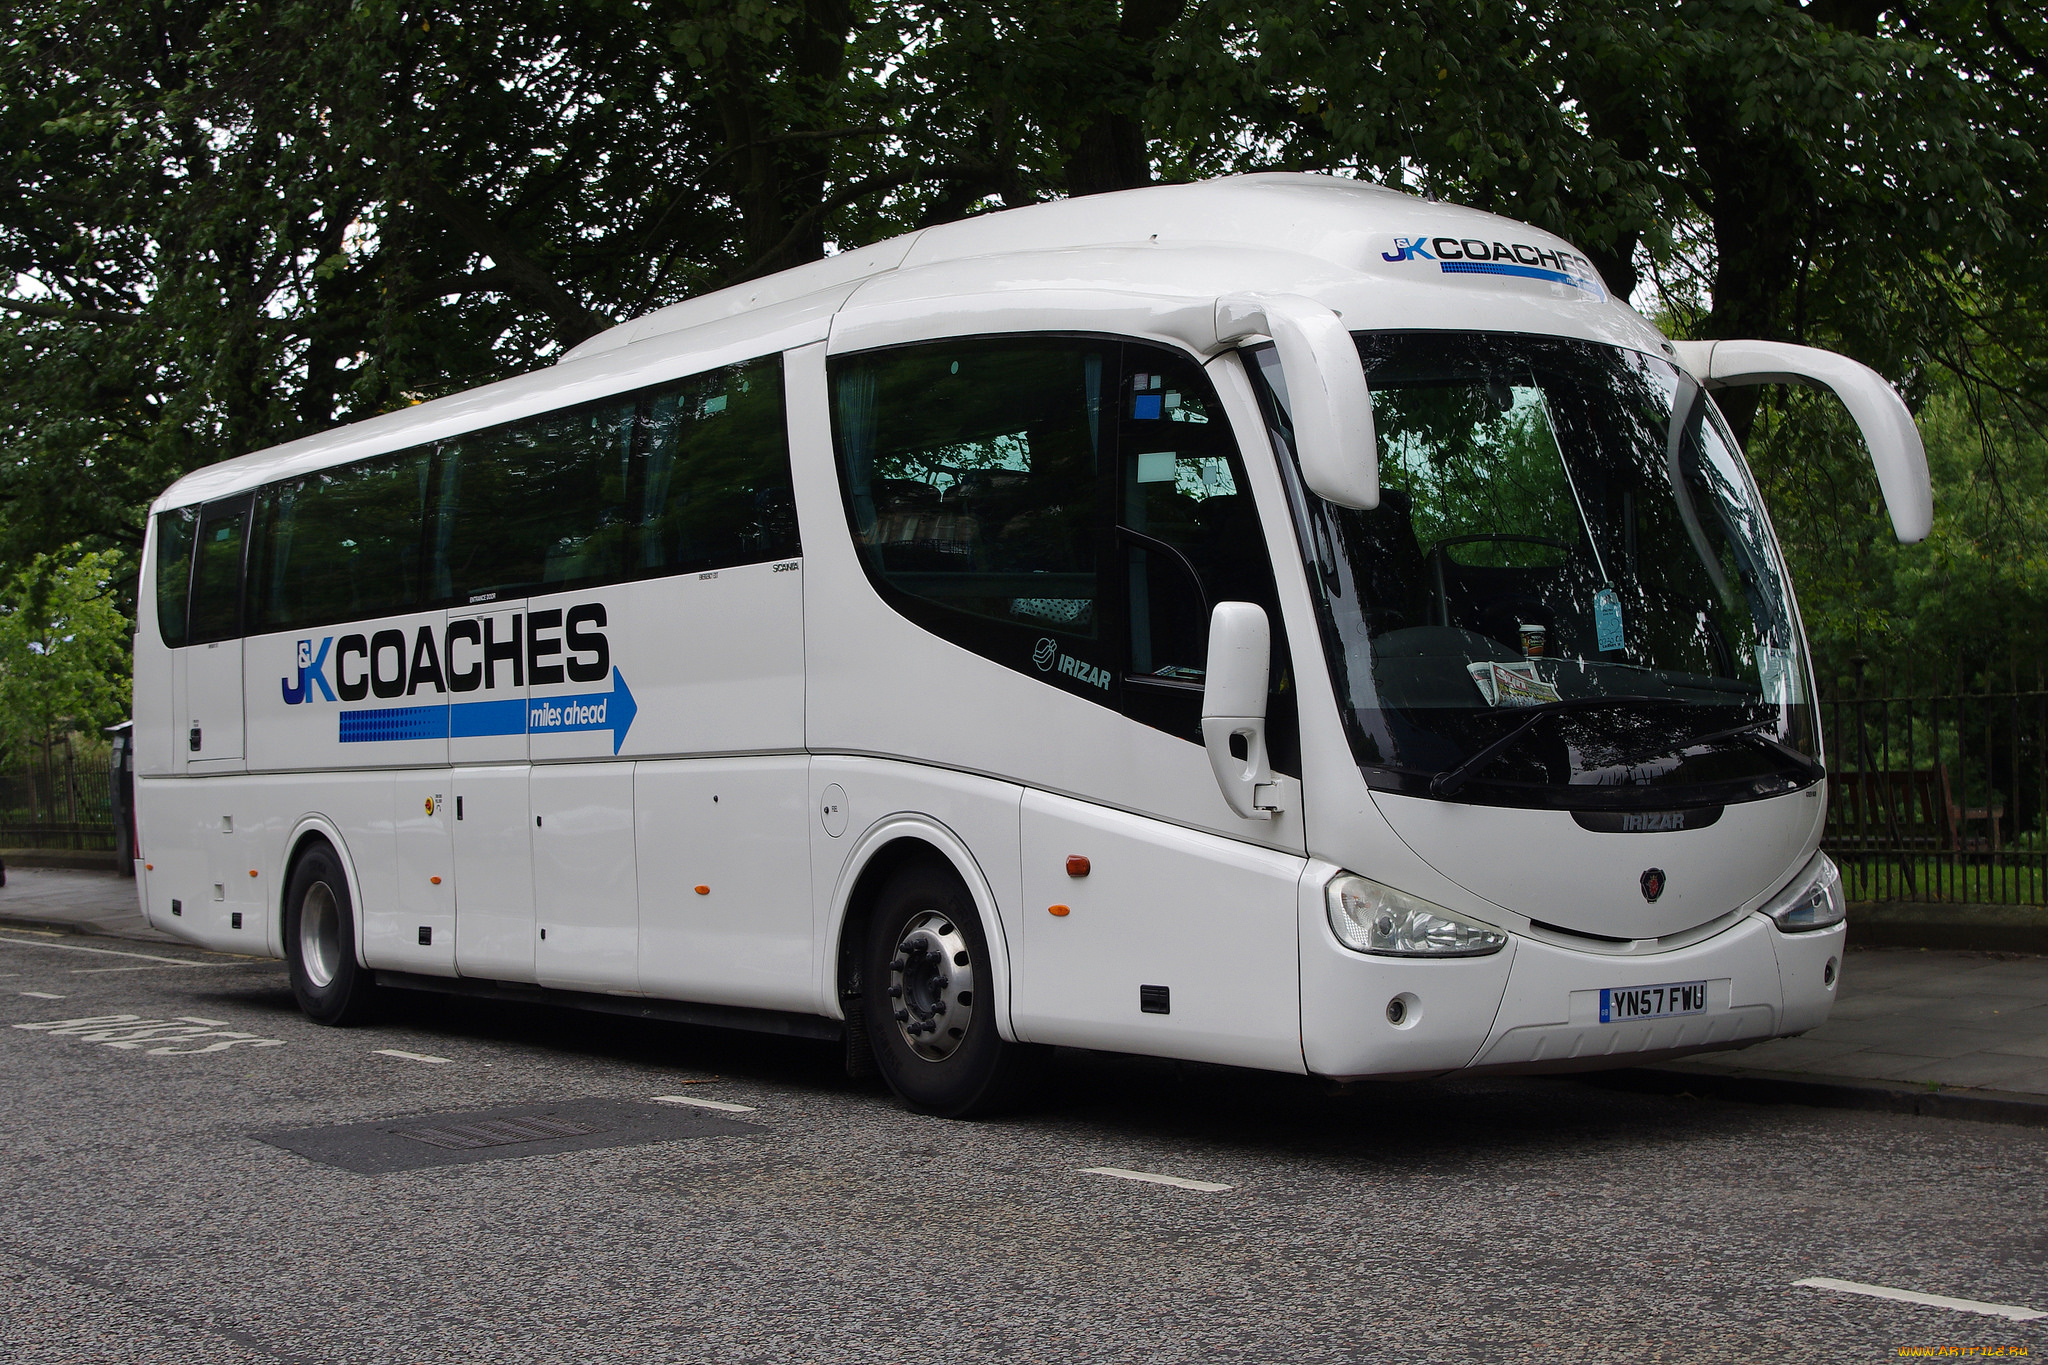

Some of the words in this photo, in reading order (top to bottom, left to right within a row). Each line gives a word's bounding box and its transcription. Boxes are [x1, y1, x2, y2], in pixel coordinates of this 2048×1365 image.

[1431, 237, 1594, 281] COACHES
[773, 561, 799, 573] SCANIA
[336, 602, 610, 702] COACHES
[1057, 653, 1112, 691] IRIZAR
[1495, 668, 1526, 690] Sun
[530, 702, 562, 727] miles
[563, 698, 607, 726] ahead
[1623, 813, 1685, 831] IRIZAR
[1614, 988, 1664, 1017] YN57
[1669, 985, 1704, 1012] FWU
